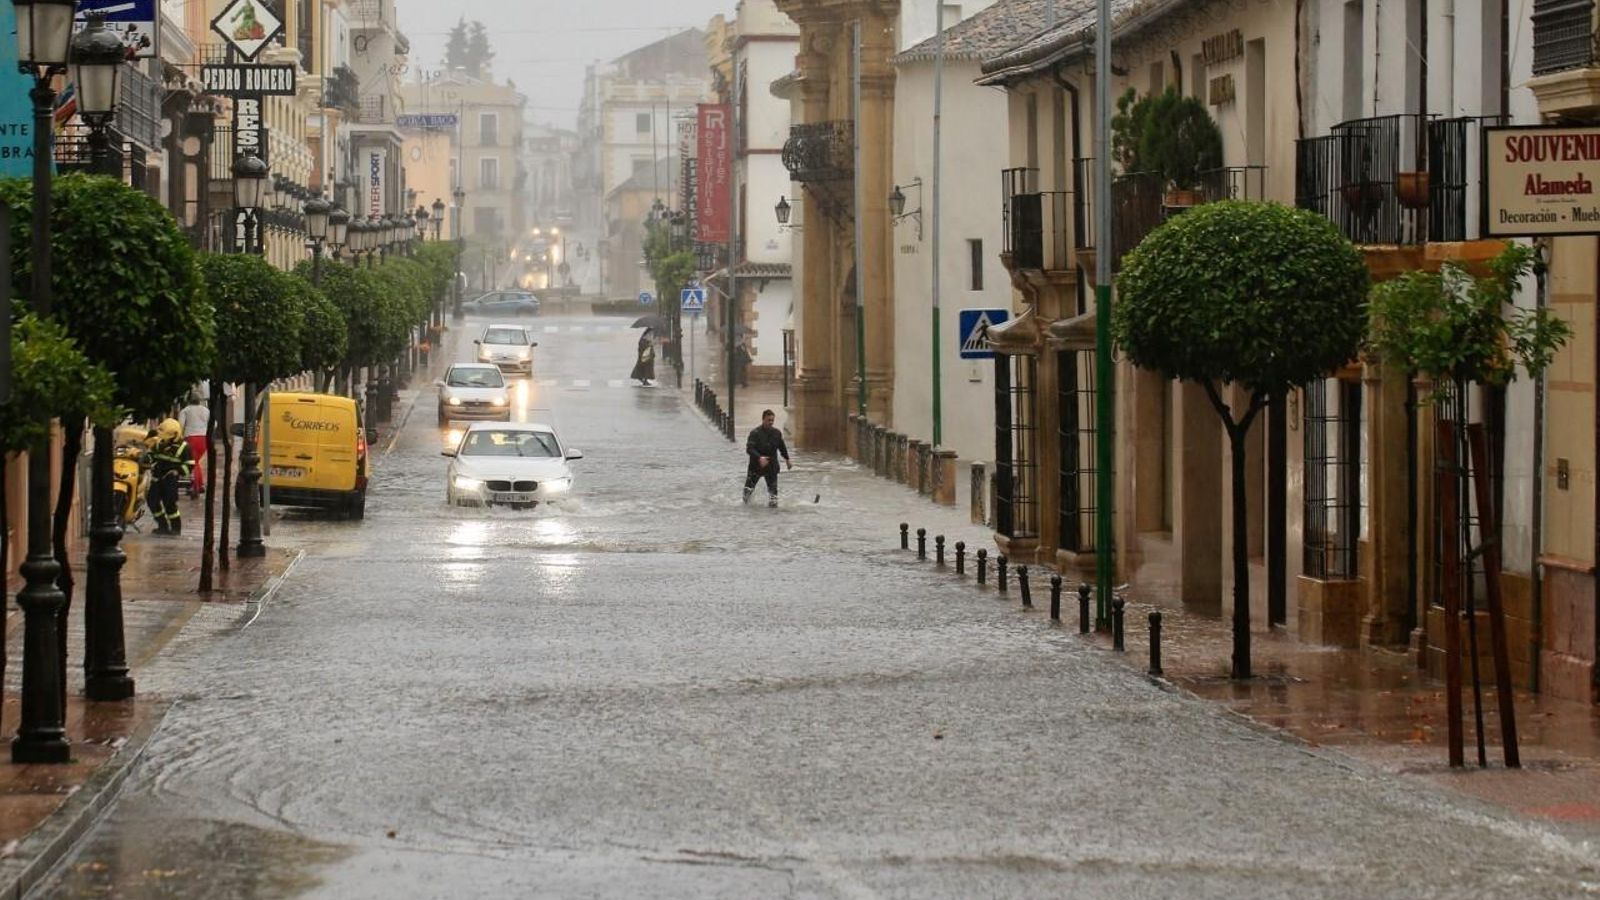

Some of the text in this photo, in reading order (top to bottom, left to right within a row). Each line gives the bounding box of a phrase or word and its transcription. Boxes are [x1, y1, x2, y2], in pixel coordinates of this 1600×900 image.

[74, 23, 123, 32] HEL
[203, 68, 292, 90] PEDRO ROMERO
[371, 153, 380, 220] INTERSPORT
[1524, 172, 1592, 195] Alameda
[1500, 207, 1557, 223] Decoración
